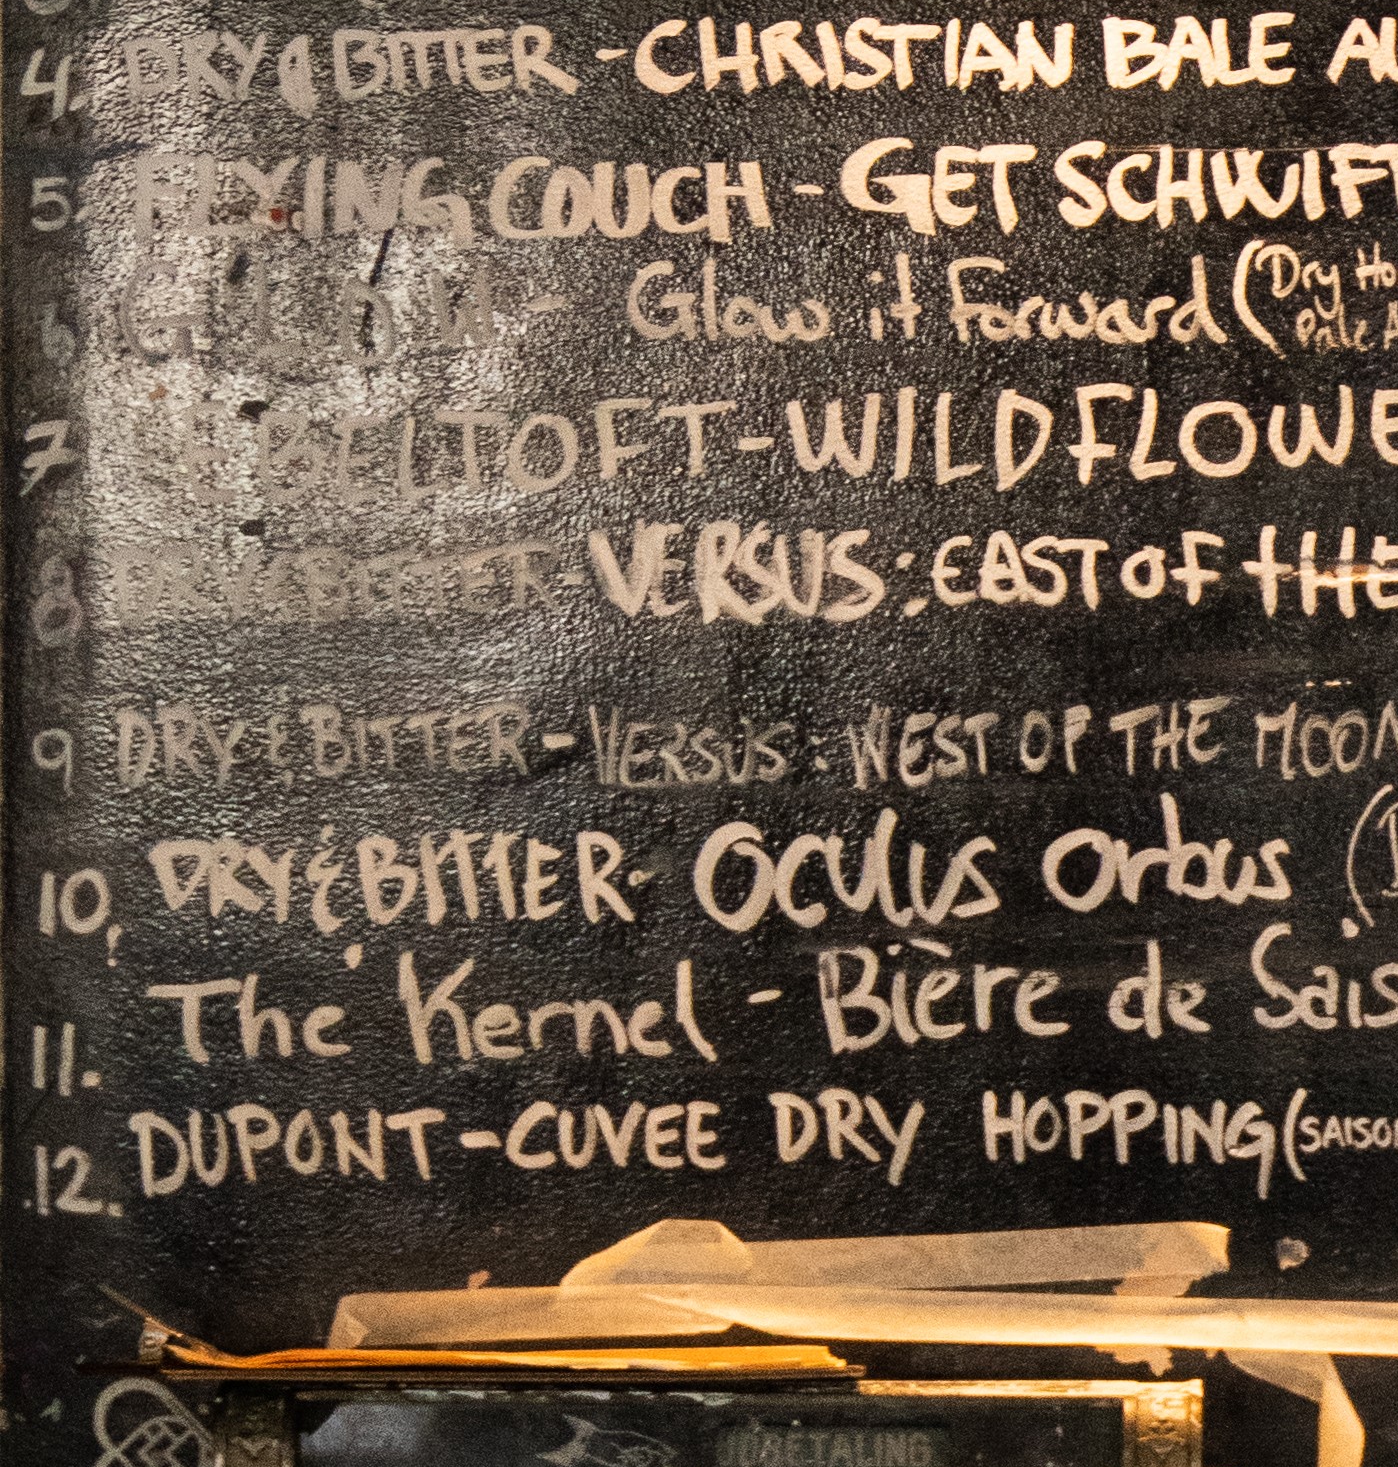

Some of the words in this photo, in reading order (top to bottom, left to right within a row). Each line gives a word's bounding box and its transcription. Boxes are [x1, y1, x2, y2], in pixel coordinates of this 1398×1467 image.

[636, 18, 1074, 94] CHRISTIAN
[1102, 12, 1296, 90] BALE
[487, 155, 774, 244] COUCH
[840, 136, 1036, 236] GET
[148, 973, 352, 1062] The
[399, 948, 717, 1064] Kernel
[1108, 938, 1210, 1038] de
[770, 1088, 925, 1186] DRY
[983, 1087, 1275, 1200] HOPPING
